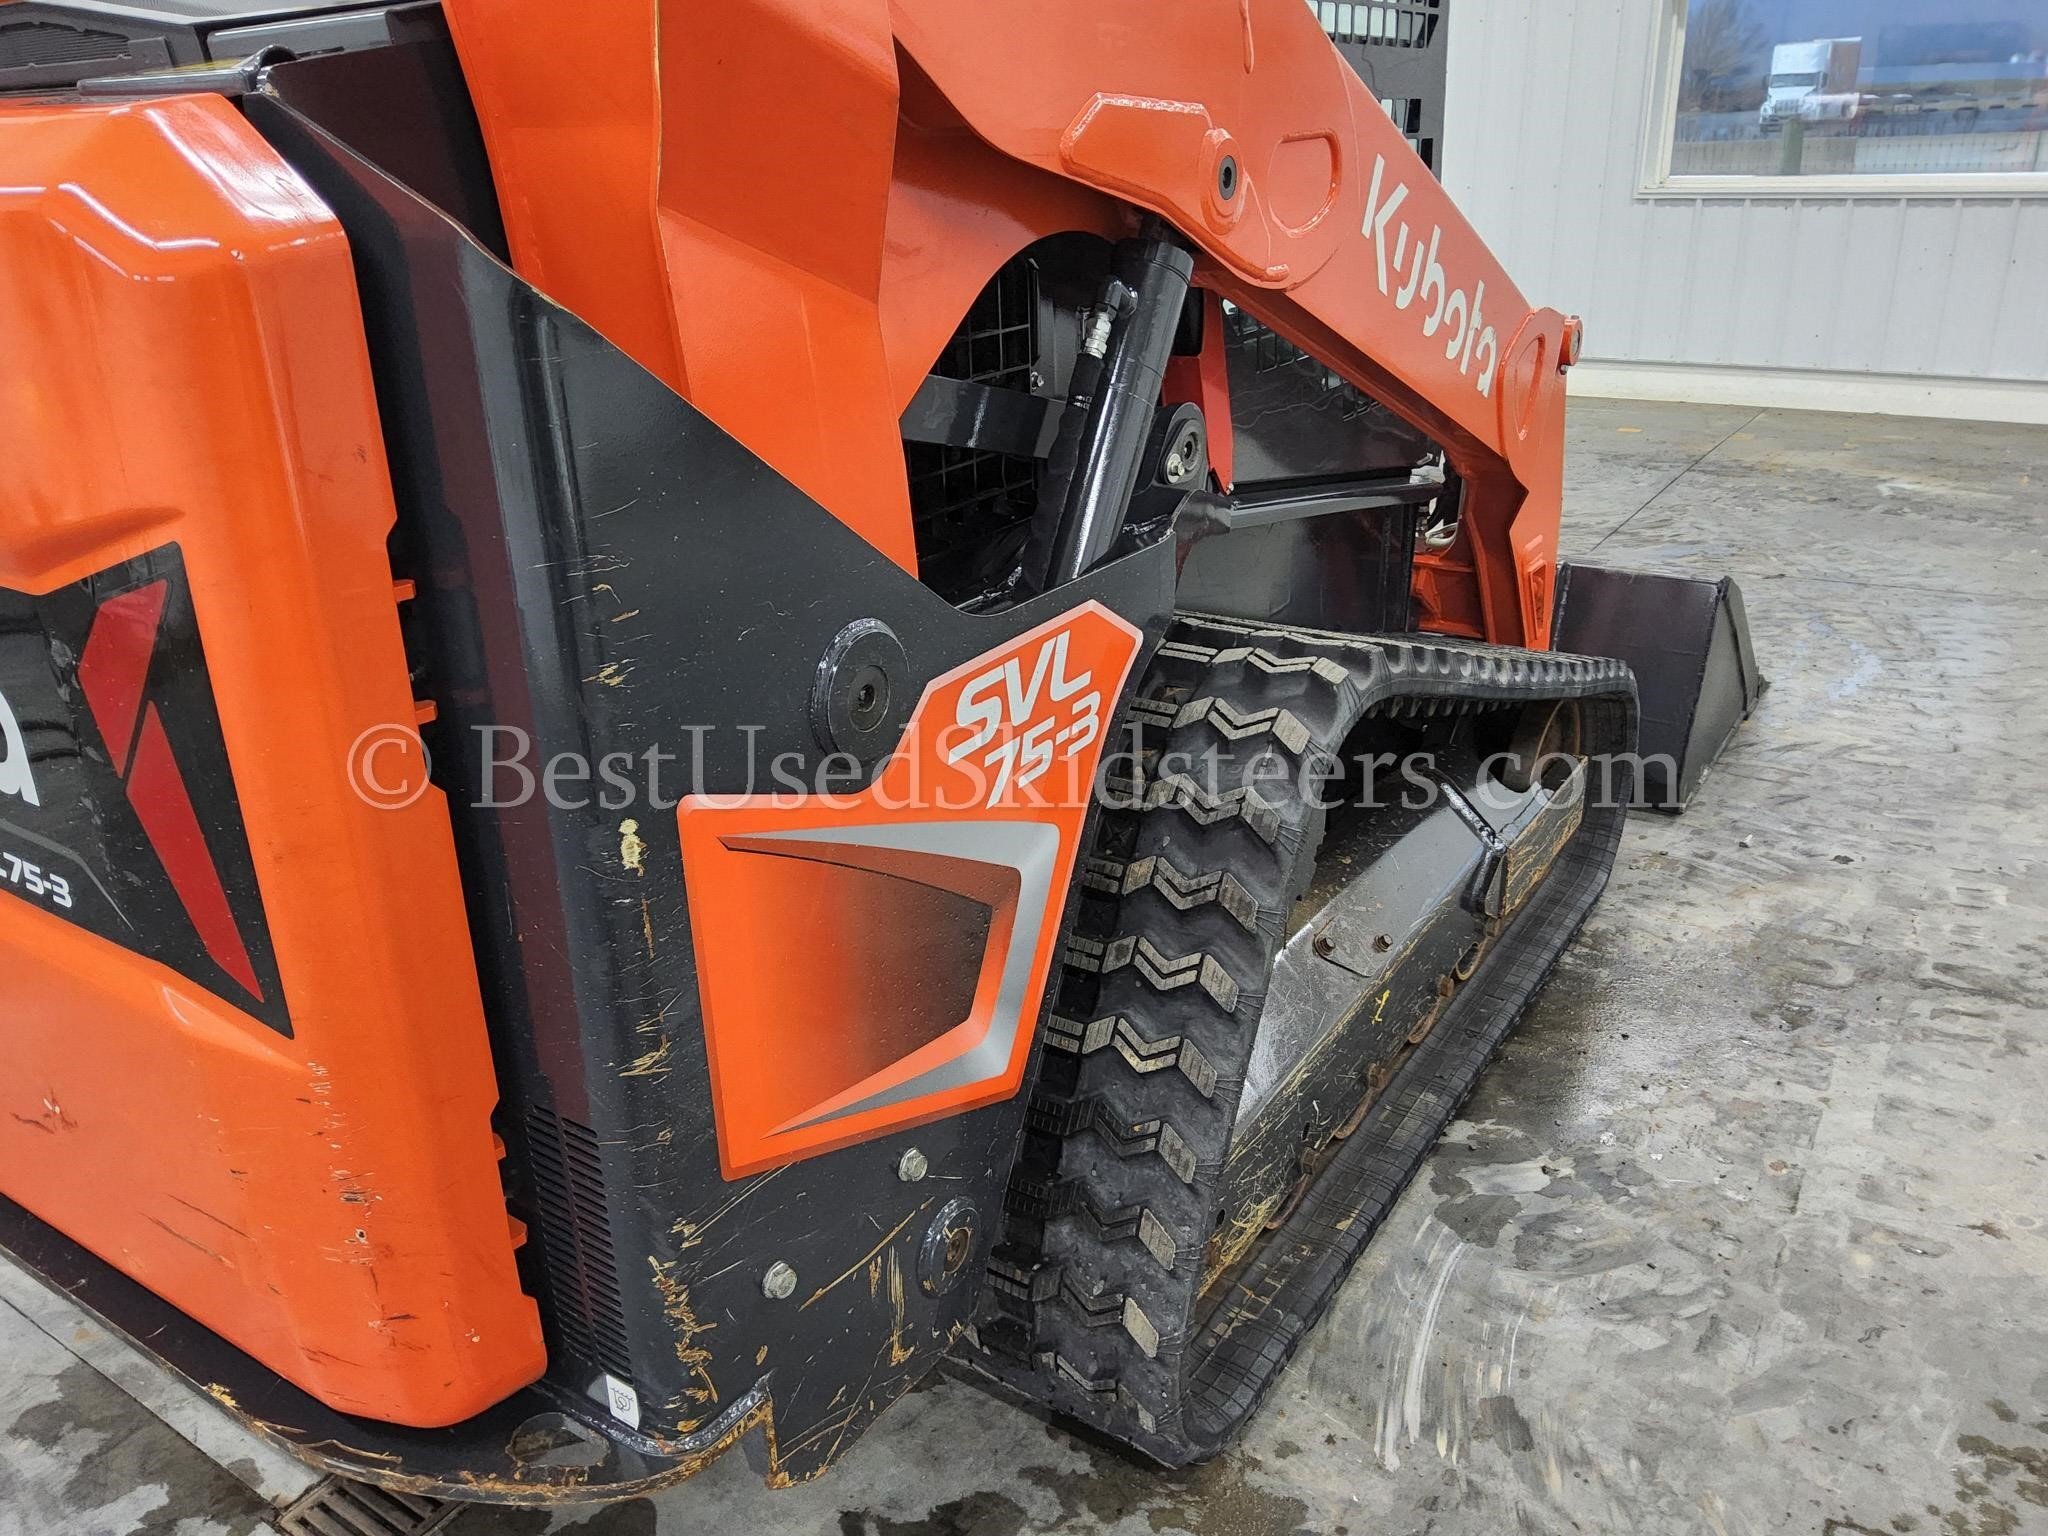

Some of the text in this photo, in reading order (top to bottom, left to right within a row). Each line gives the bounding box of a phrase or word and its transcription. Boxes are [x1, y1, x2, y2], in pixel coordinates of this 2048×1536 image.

[1361, 152, 1497, 399] Kubota
[948, 629, 1092, 766] SVL
[984, 691, 1101, 811] 75-3
[0, 852, 73, 908] 75-3
